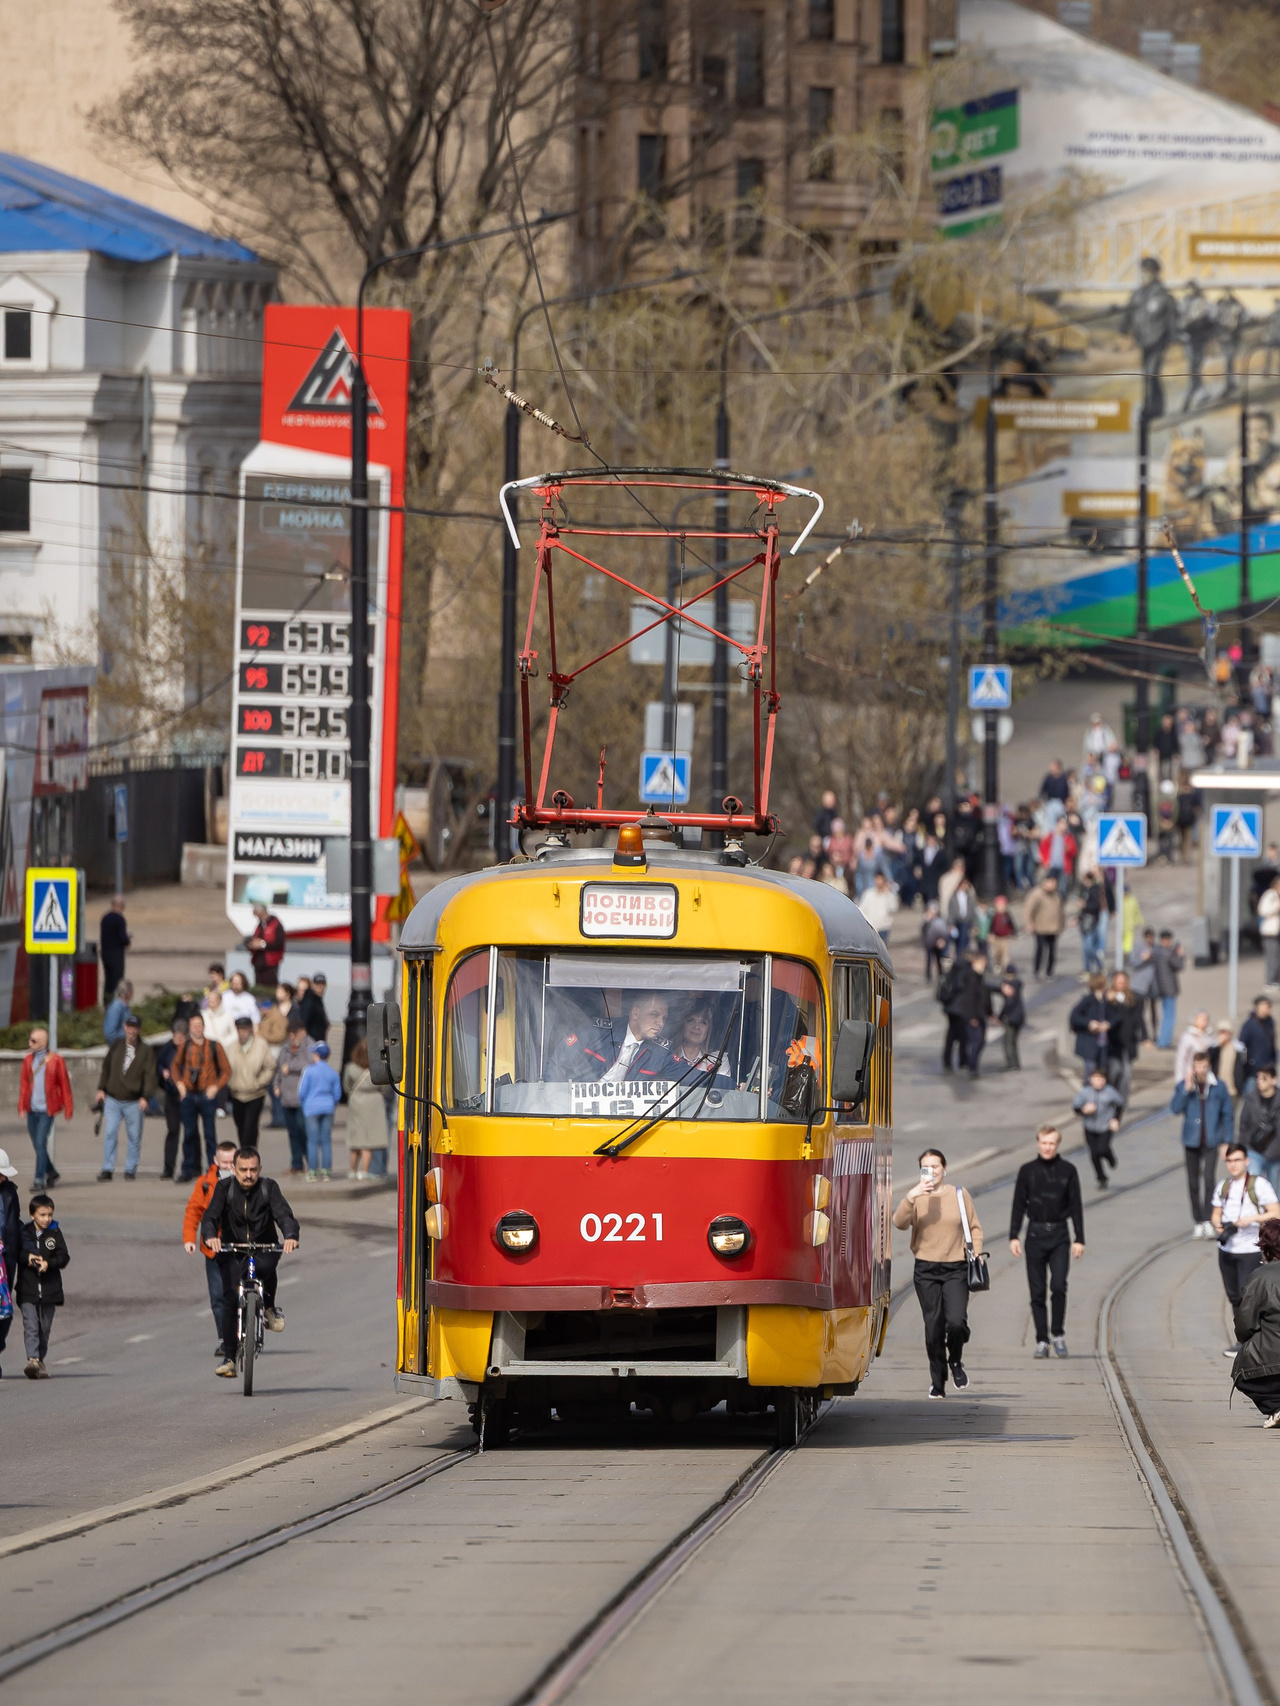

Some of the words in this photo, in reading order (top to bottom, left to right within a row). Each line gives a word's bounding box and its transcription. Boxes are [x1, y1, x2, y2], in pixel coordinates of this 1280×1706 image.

[279, 508, 344, 528] МОЙКА
[283, 622, 350, 655] 63.5
[282, 664, 349, 697] 69.9
[280, 706, 347, 739] 92.5
[282, 748, 351, 782] 78.0
[237, 836, 322, 858] МАГАЗИН
[586, 893, 673, 911] ПОЛИВО
[574, 1081, 669, 1099] ПОСАДКИ
[579, 1212, 663, 1242] 0221
